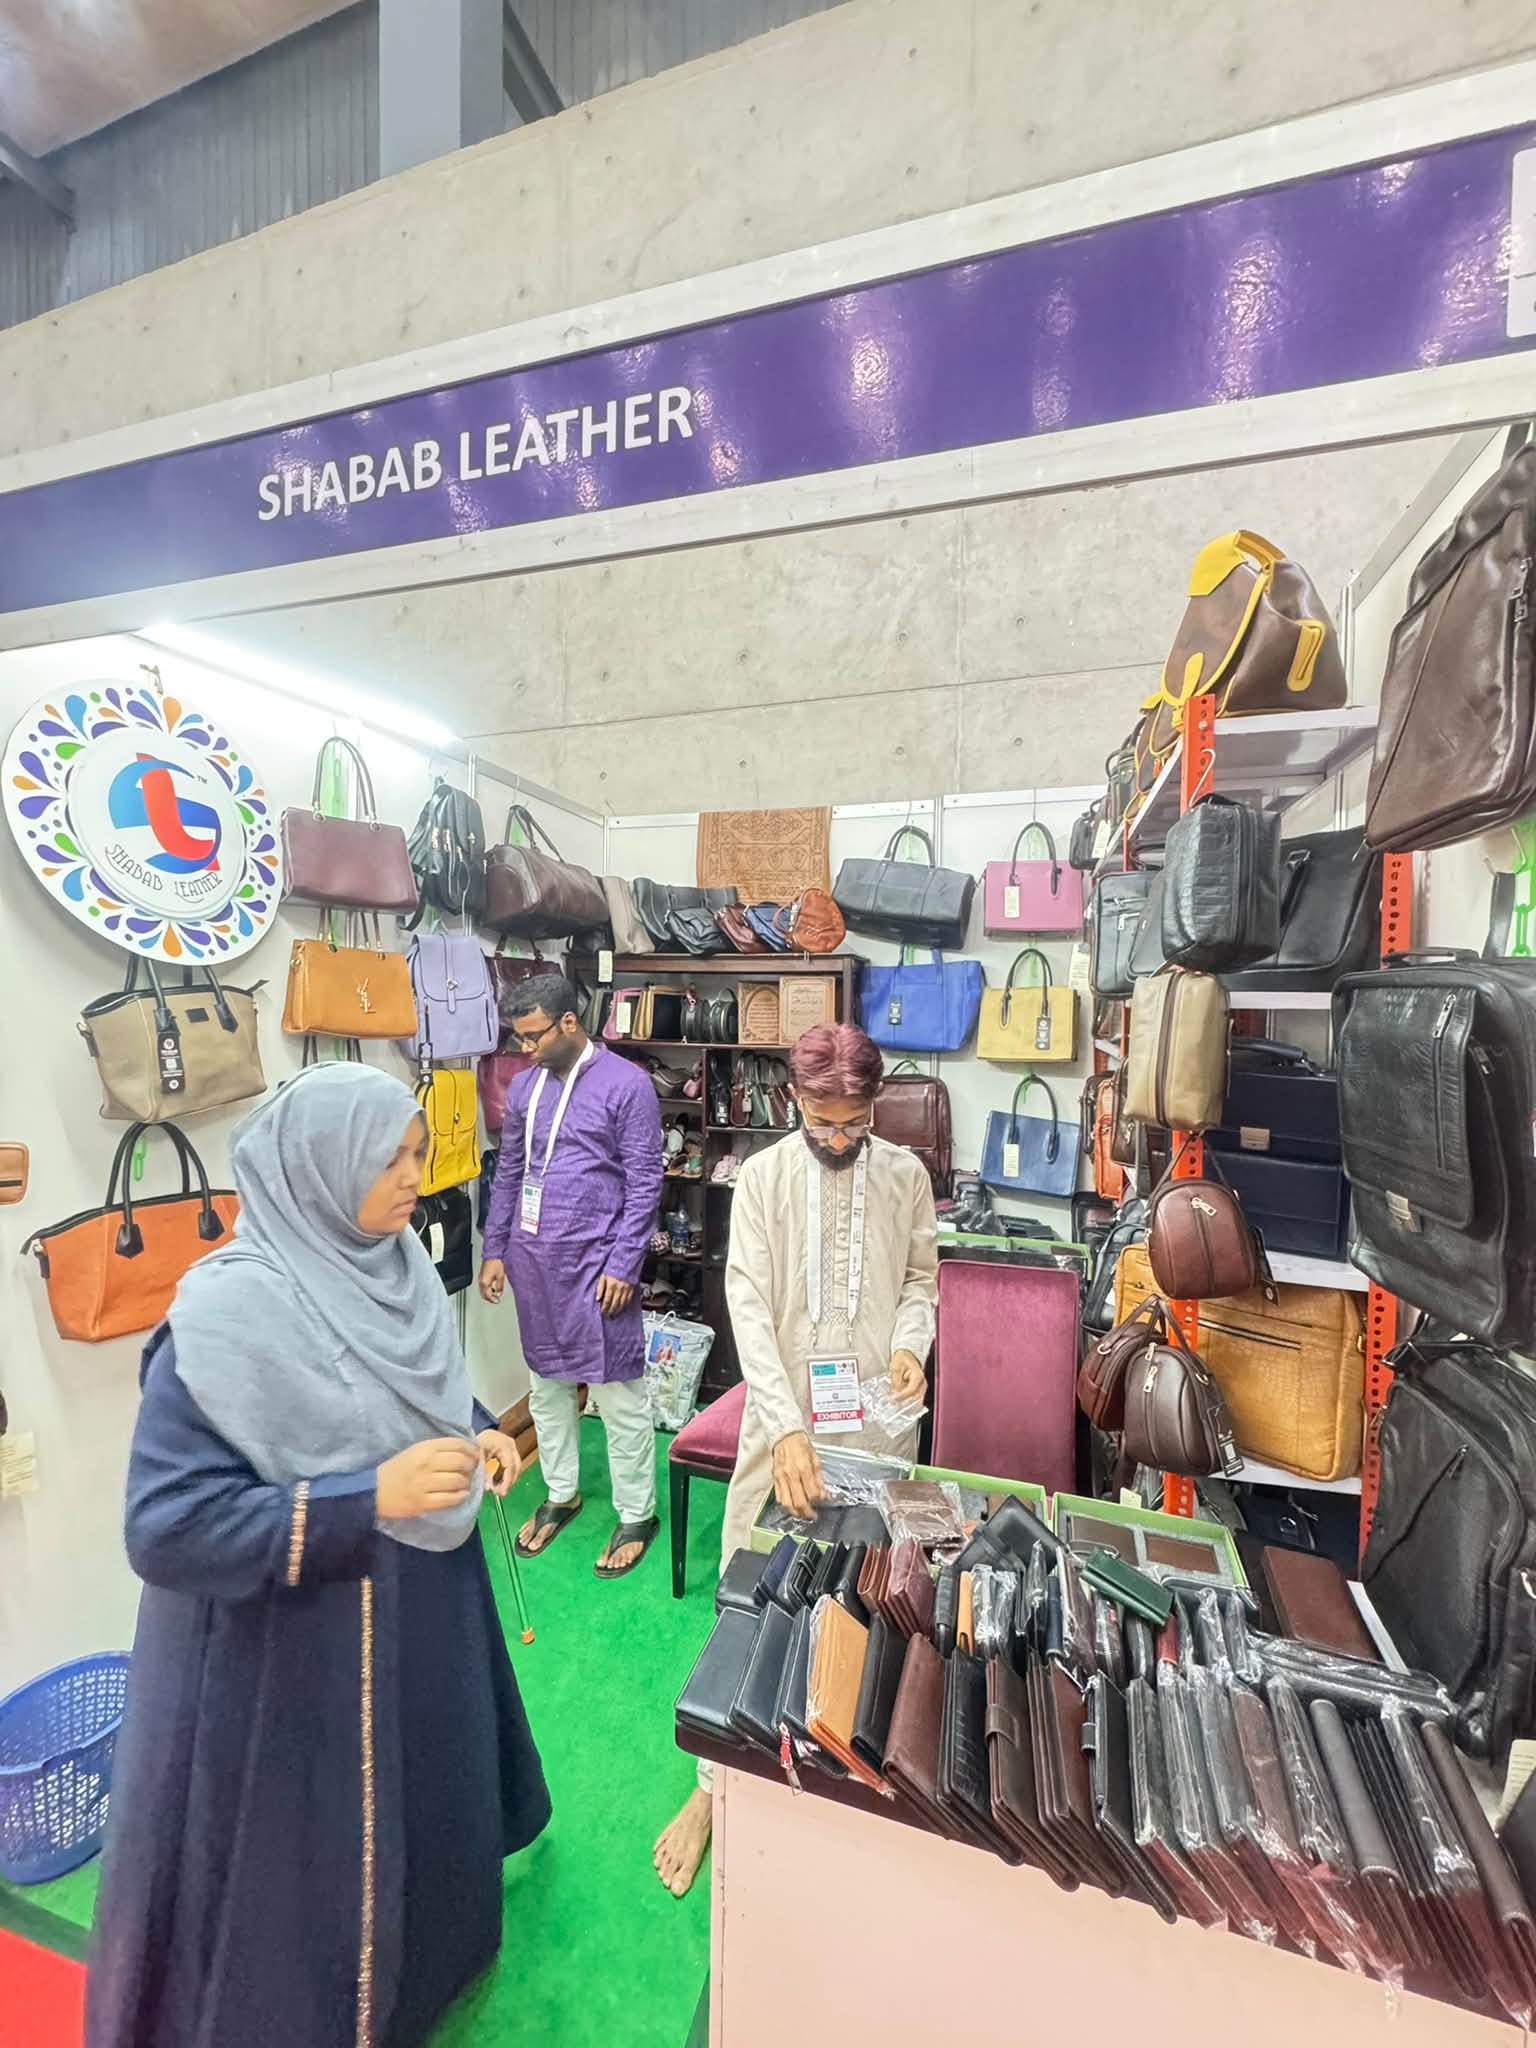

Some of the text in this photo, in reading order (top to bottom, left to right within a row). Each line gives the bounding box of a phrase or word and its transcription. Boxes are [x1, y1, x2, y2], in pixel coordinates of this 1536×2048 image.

[257, 385, 694, 522] SHABAB LEATHER
[174, 871, 223, 904] LEATHER
[816, 1410, 859, 1421] EXHIBITOR
